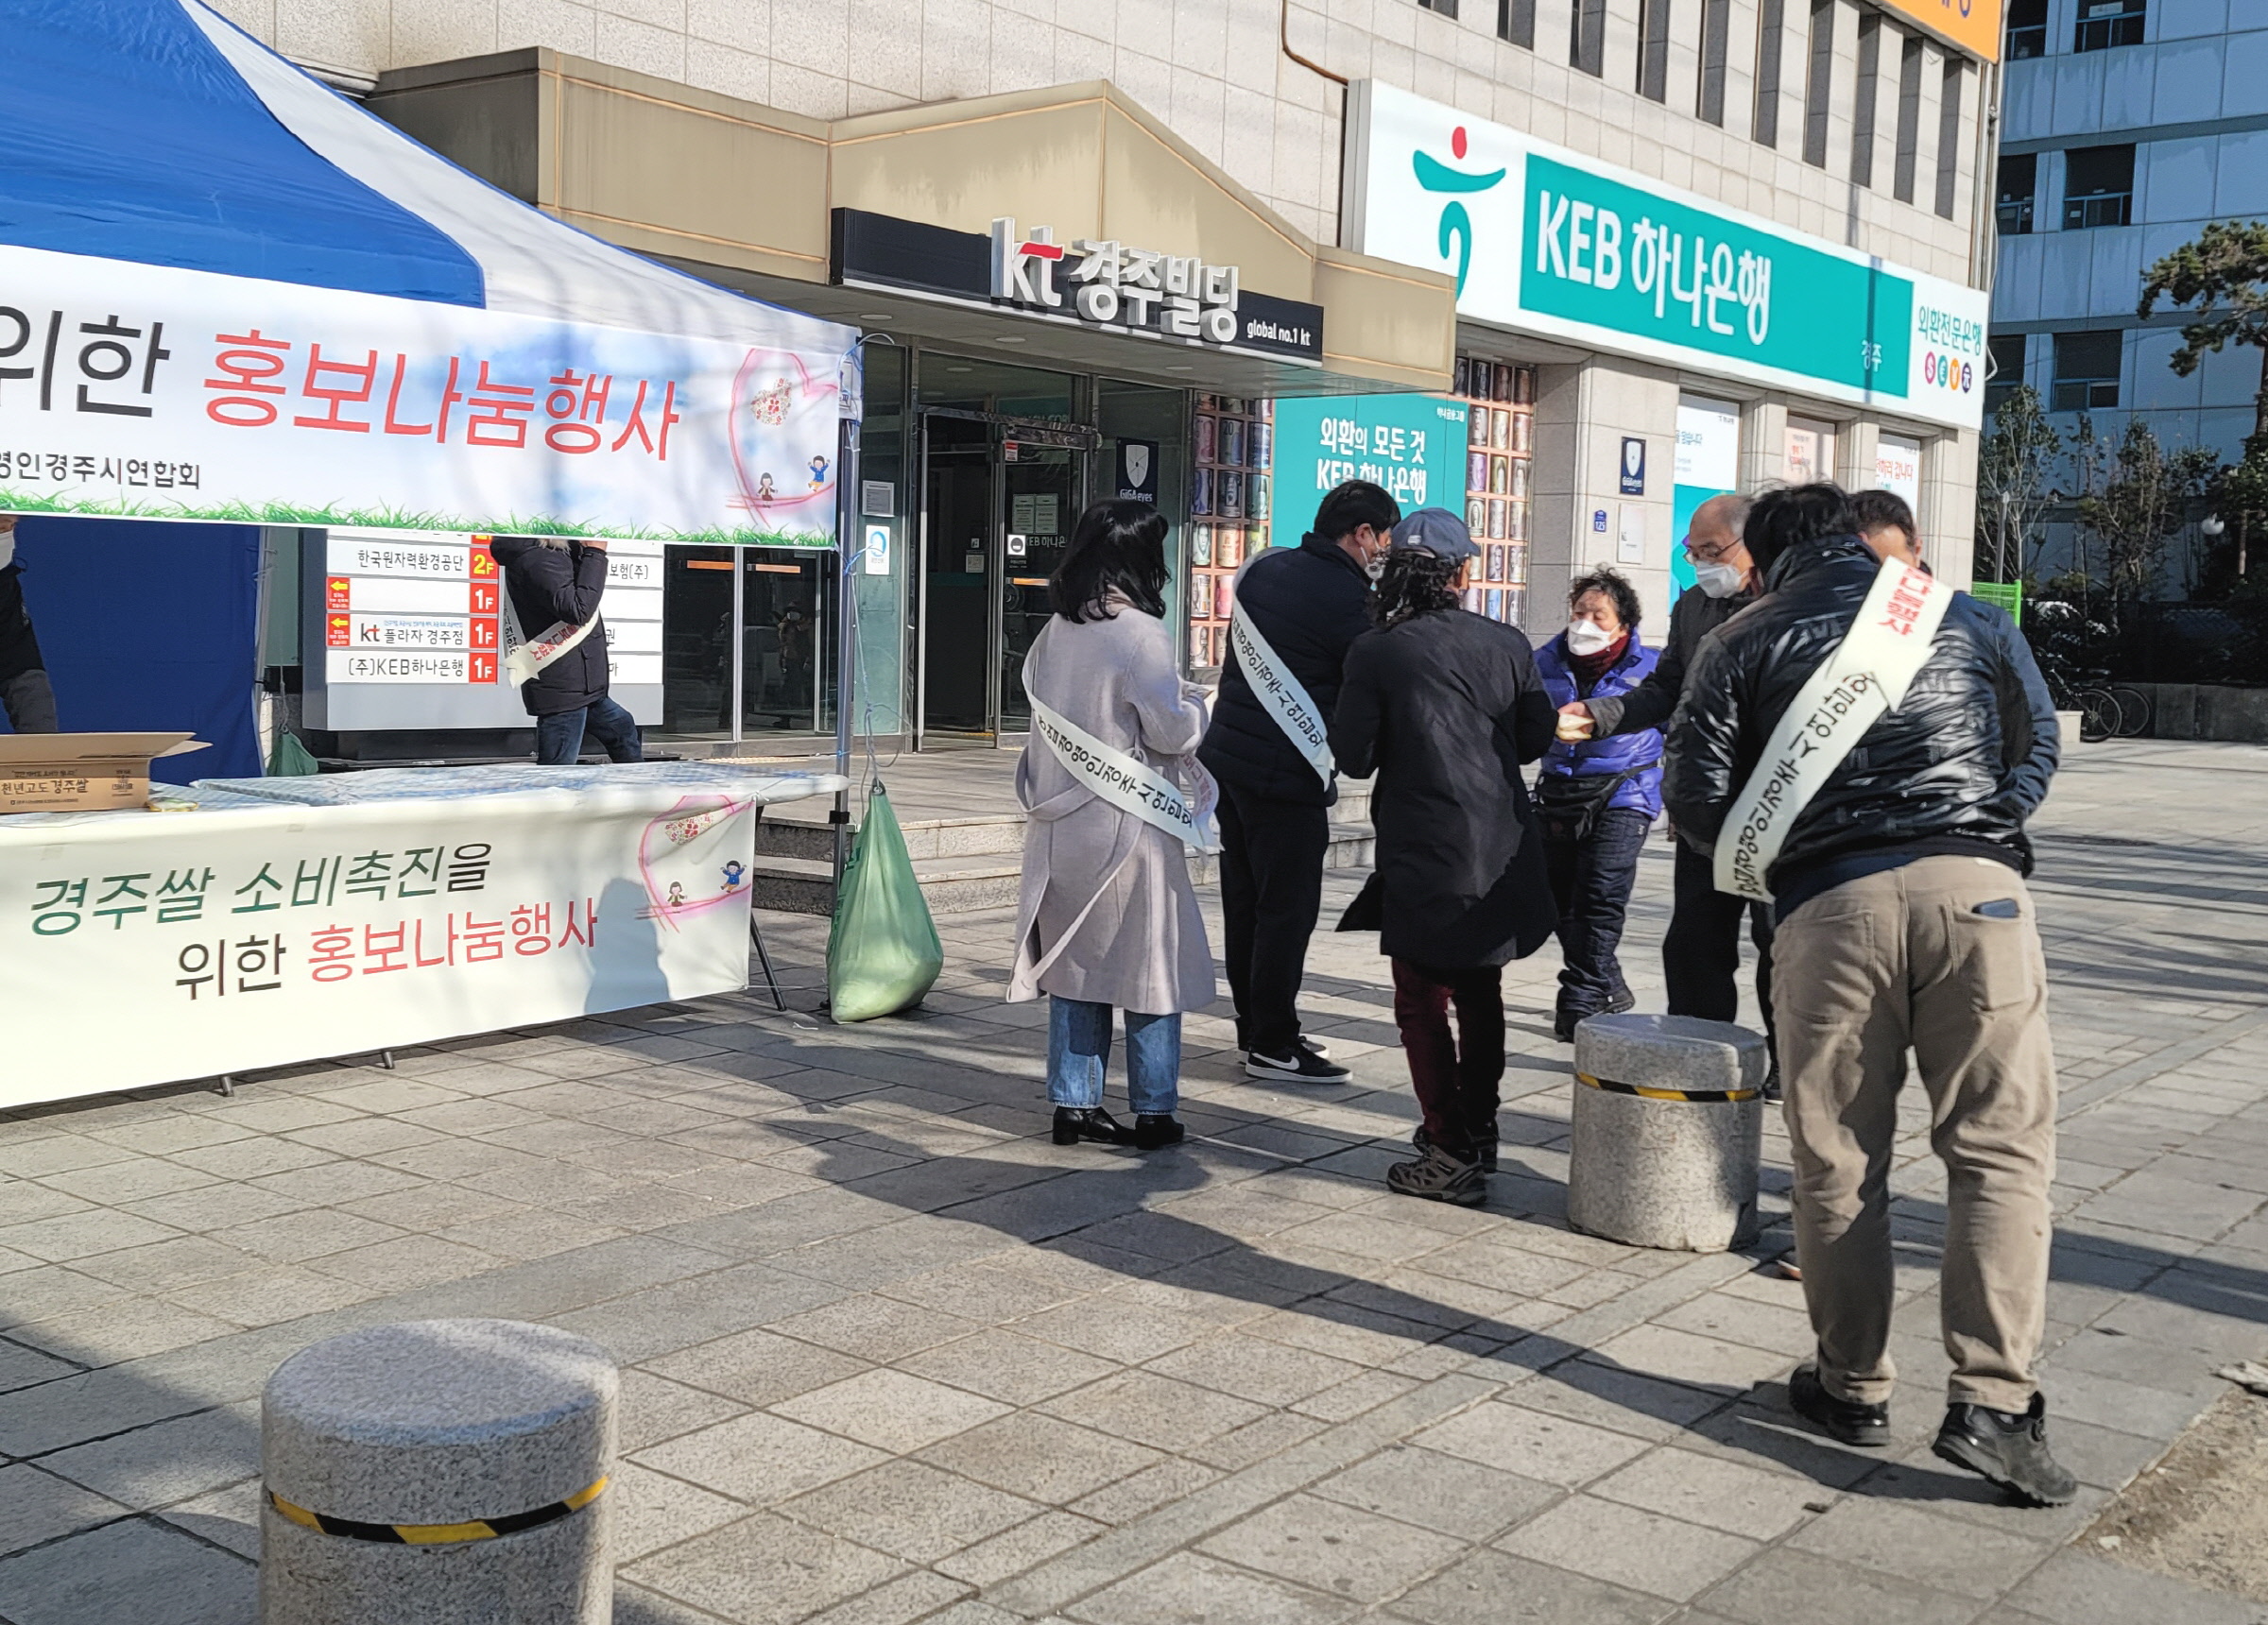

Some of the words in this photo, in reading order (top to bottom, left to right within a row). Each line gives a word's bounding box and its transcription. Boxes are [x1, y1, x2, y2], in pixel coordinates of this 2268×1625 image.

[991, 216, 1065, 307] kt
[1069, 239, 1239, 342] 경주빌딩
[1537, 190, 1622, 290] KEB
[1631, 215, 1771, 346] 하나은행
[1246, 319, 1278, 341] global
[1278, 327, 1298, 344] no.1
[1299, 327, 1312, 347] kt
[1918, 305, 1983, 356] 외환전문은행
[1861, 339, 1882, 373] 경주
[204, 329, 680, 461] 홍보나눔행사
[1319, 417, 1368, 455] 외환의
[1372, 424, 1406, 462] 모든
[1410, 430, 1426, 465] 것
[357, 549, 464, 573] 한국원자력환경공단
[472, 554, 494, 575] 2F
[473, 590, 494, 610] 1F
[359, 623, 381, 642] kt
[383, 627, 423, 645] 플라자
[426, 629, 464, 646] 경주점
[473, 625, 494, 646] 1F
[473, 658, 494, 678] 1F
[1, 782, 49, 795] 천년고도
[51, 778, 89, 794] 경주쌀
[29, 866, 216, 936] 경주쌀
[230, 843, 491, 915] 소비촉진을
[175, 932, 287, 1001] 위한
[307, 897, 599, 984] 홍보나눔행사
